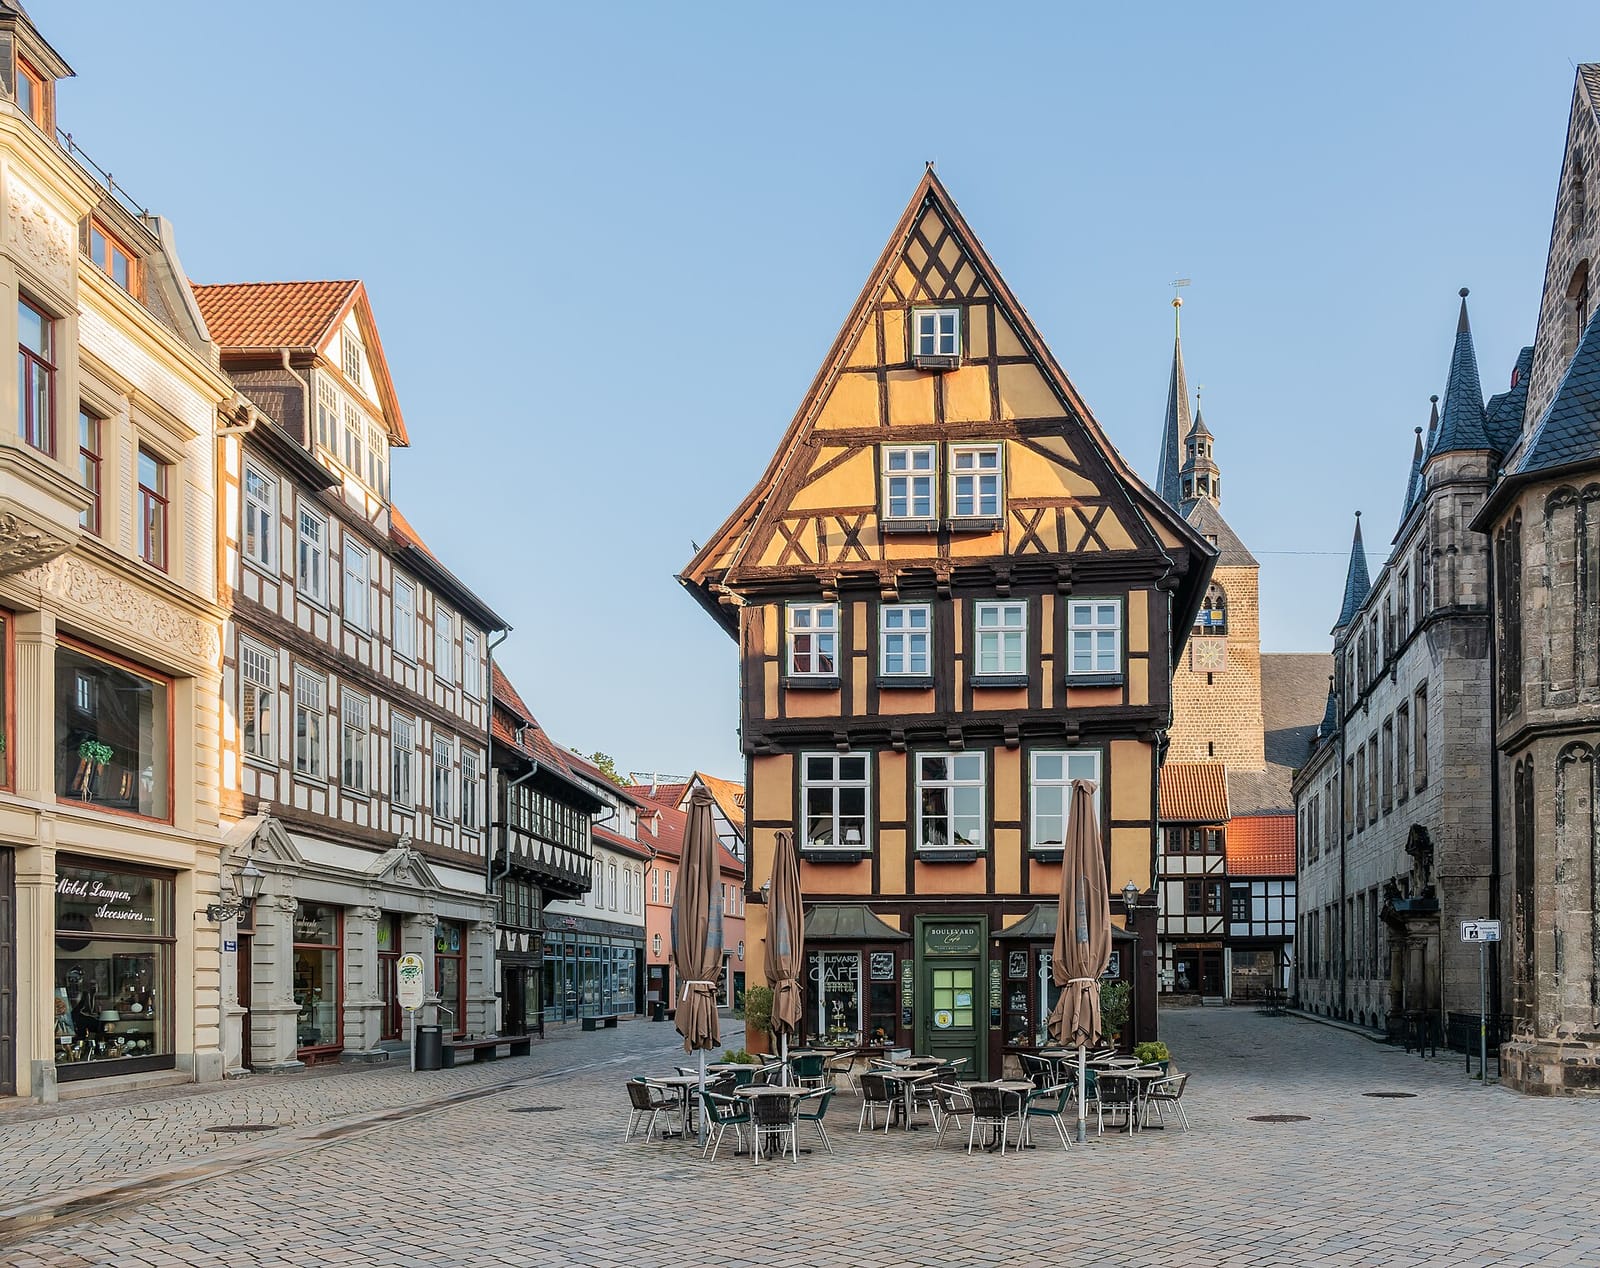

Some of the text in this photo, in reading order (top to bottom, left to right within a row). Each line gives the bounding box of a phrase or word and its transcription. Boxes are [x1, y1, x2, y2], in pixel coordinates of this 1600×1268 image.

[55, 878, 131, 903] Möbel, Lampen,
[95, 903, 143, 921] Accessoires
[809, 955, 859, 964] BOULEVARD
[809, 962, 859, 981] CAFÉ
